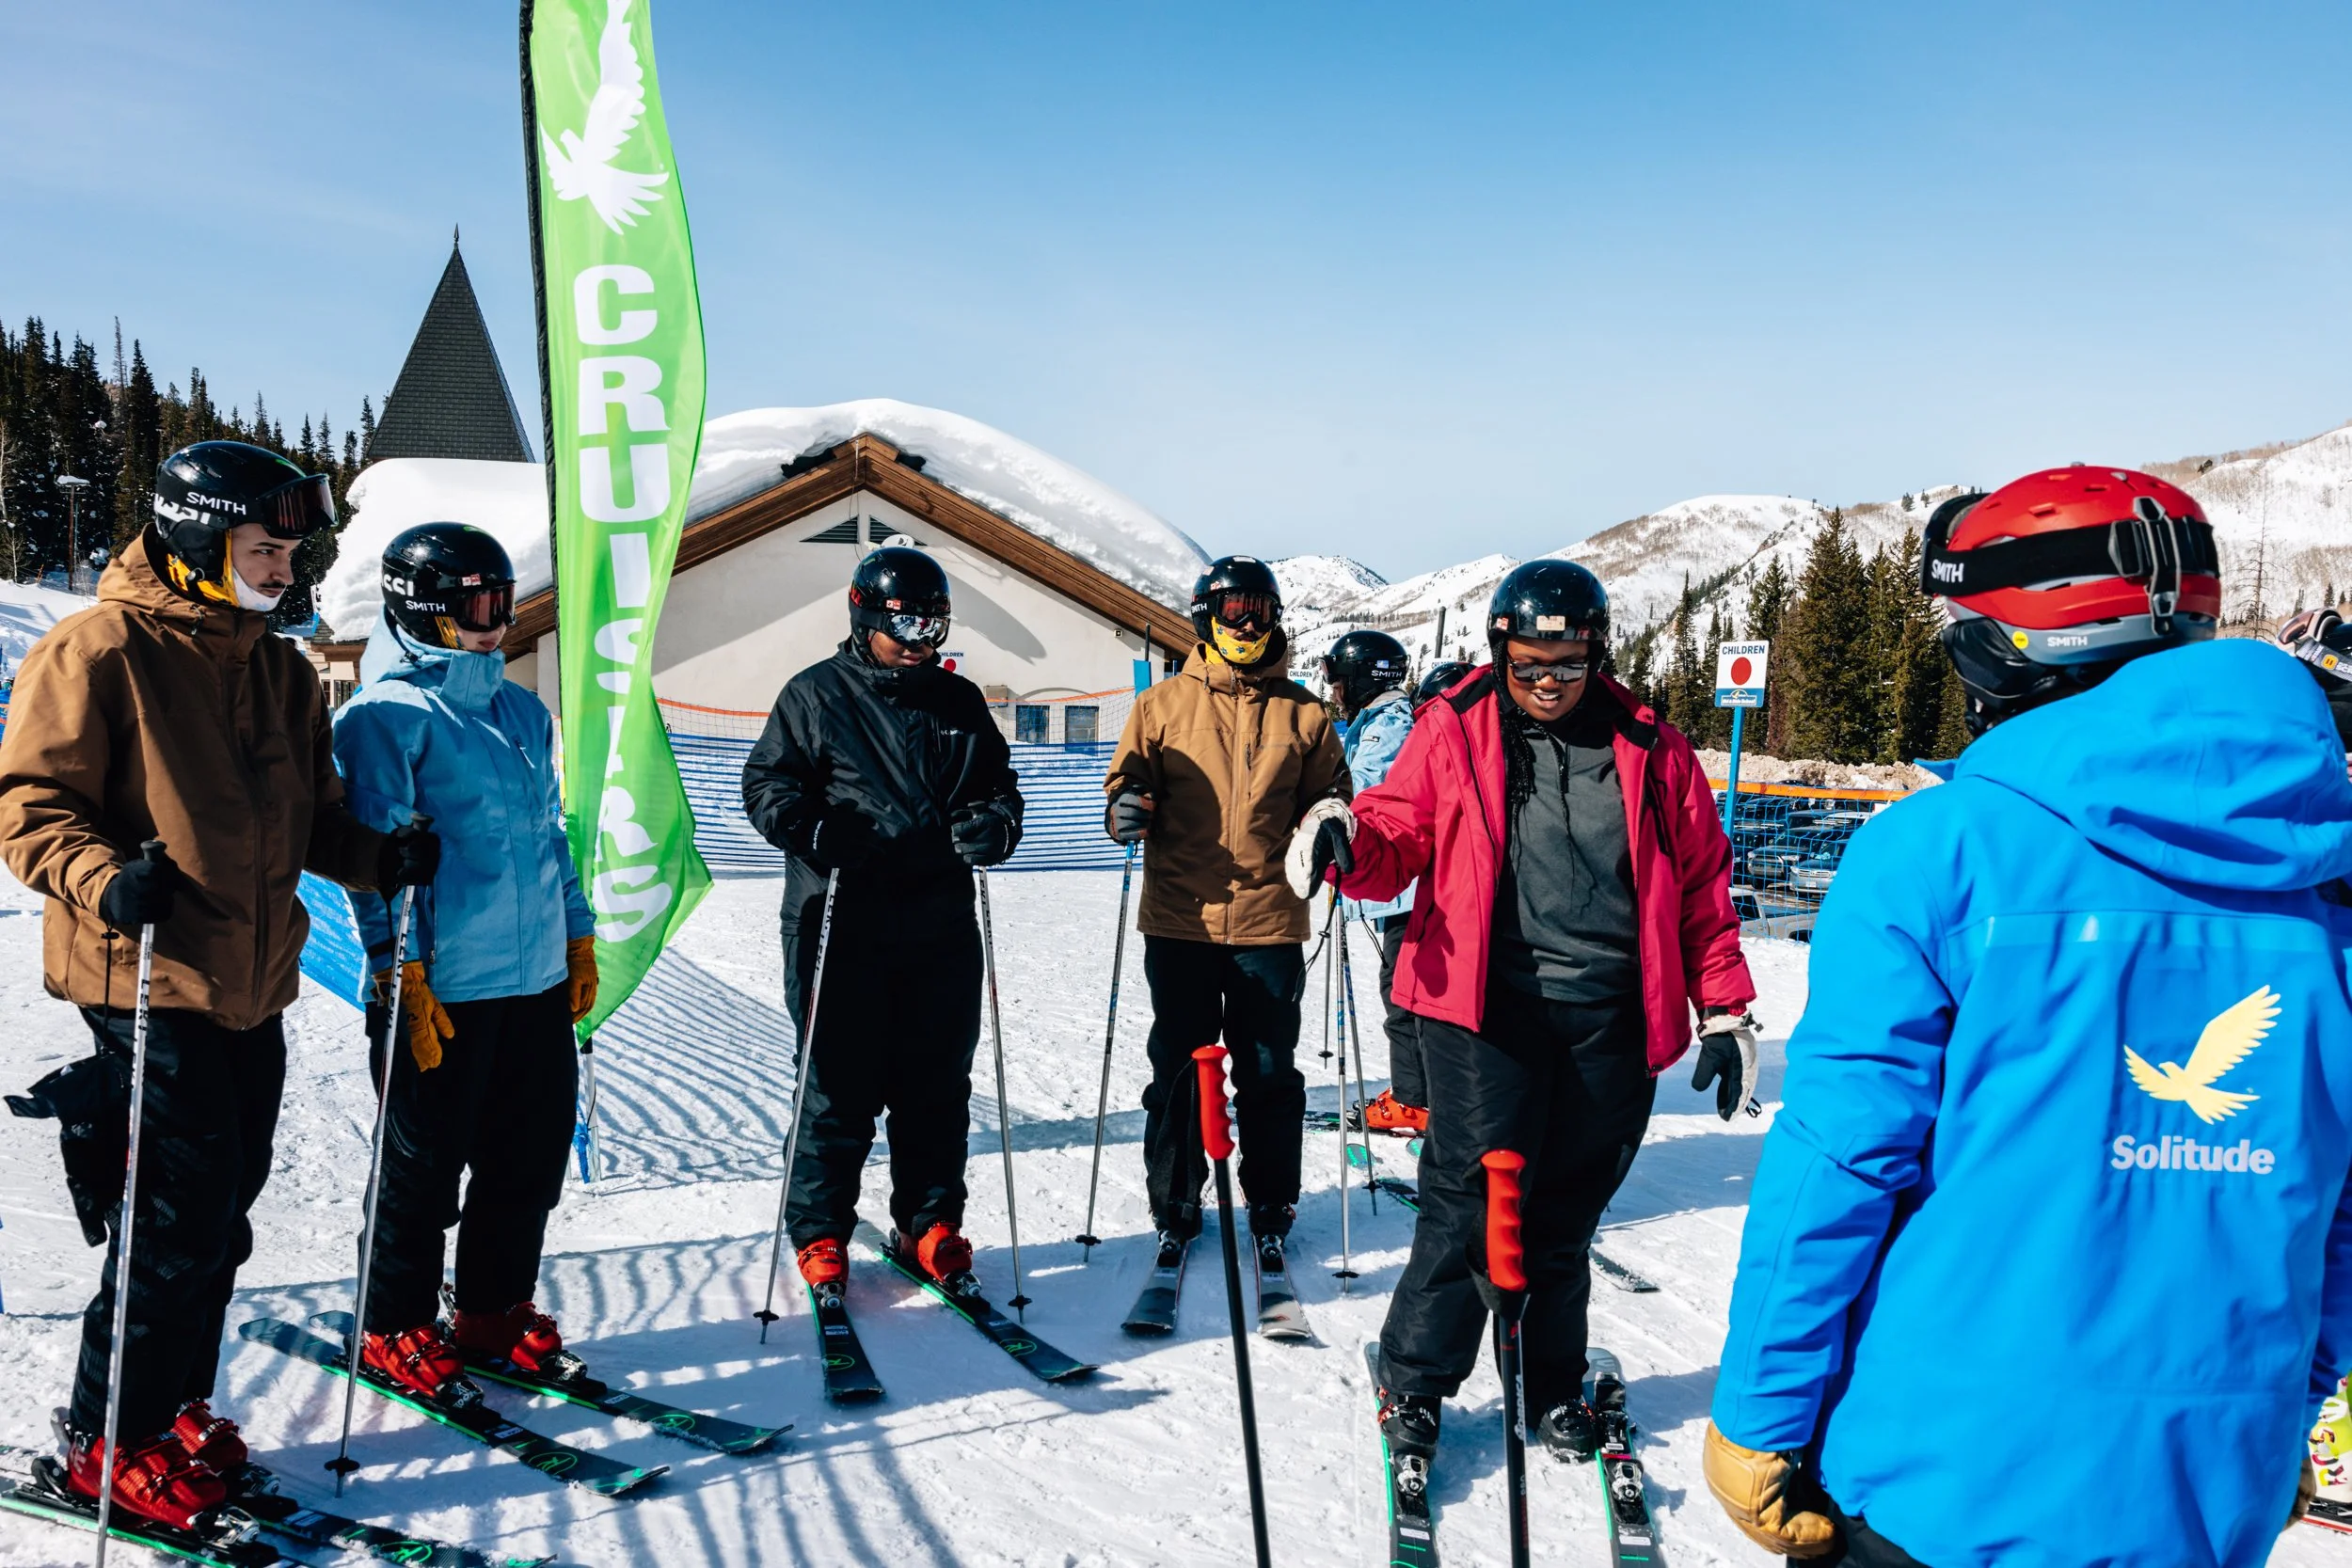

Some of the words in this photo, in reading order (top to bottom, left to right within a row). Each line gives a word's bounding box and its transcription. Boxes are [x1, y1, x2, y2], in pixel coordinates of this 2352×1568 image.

[186, 492, 246, 515] SMITH
[1931, 559, 1964, 583] SMITH
[405, 600, 446, 612] SMITH
[2047, 636, 2089, 648] SMITH
[1722, 645, 1765, 655] CHILDREN
[1289, 670, 1313, 678] CHILDREN
[1371, 670, 1403, 678] SMITH
[137, 978, 151, 1032] LEKI
[2110, 1134, 2276, 1175] Solitude
